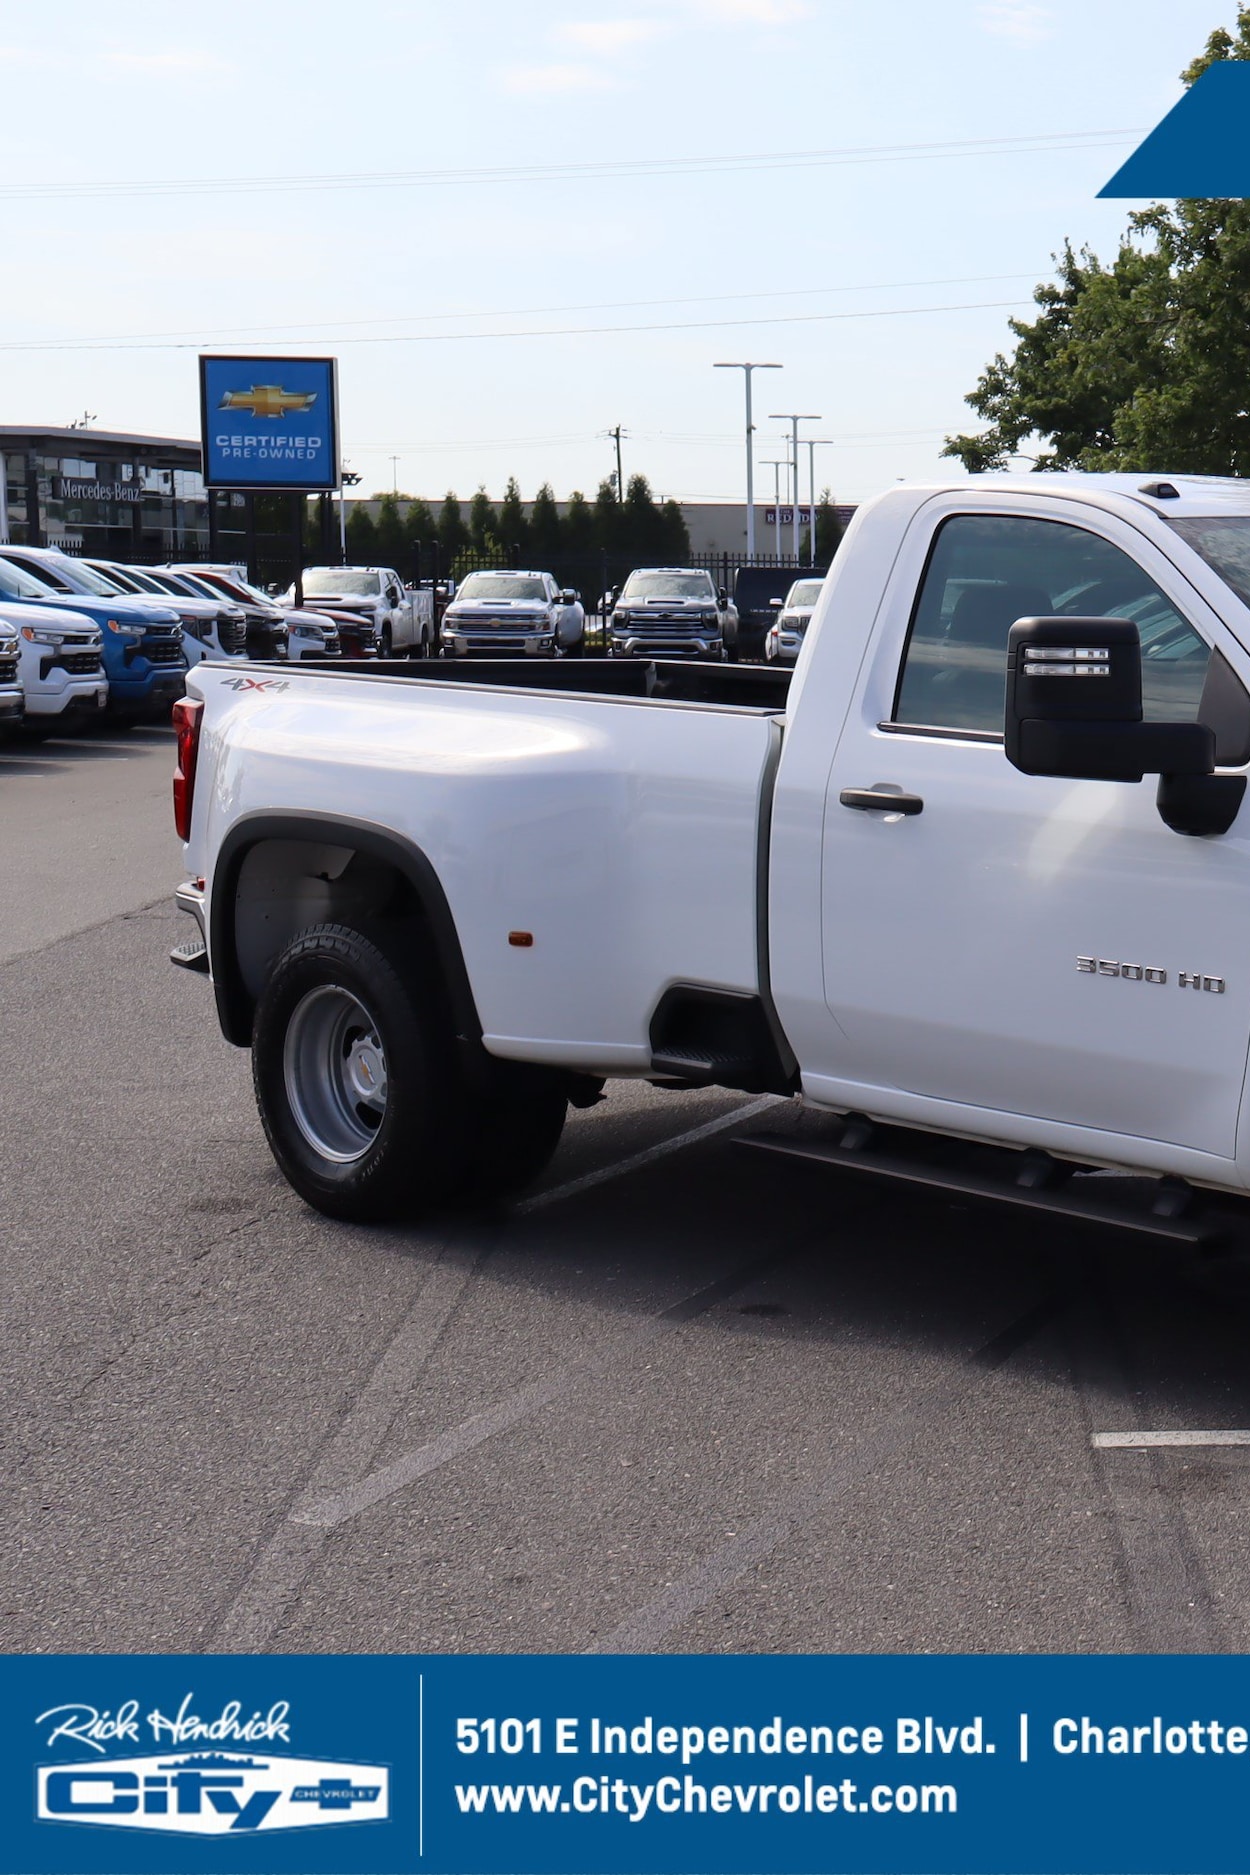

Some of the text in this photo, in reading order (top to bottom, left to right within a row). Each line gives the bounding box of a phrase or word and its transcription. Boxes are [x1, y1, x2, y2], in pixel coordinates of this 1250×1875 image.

[215, 435, 322, 448] CERTIFIED
[222, 447, 316, 460] PRE-OWNED
[60, 478, 140, 502] Mercedes-Benz
[1076, 955, 1226, 994] 3500 HD
